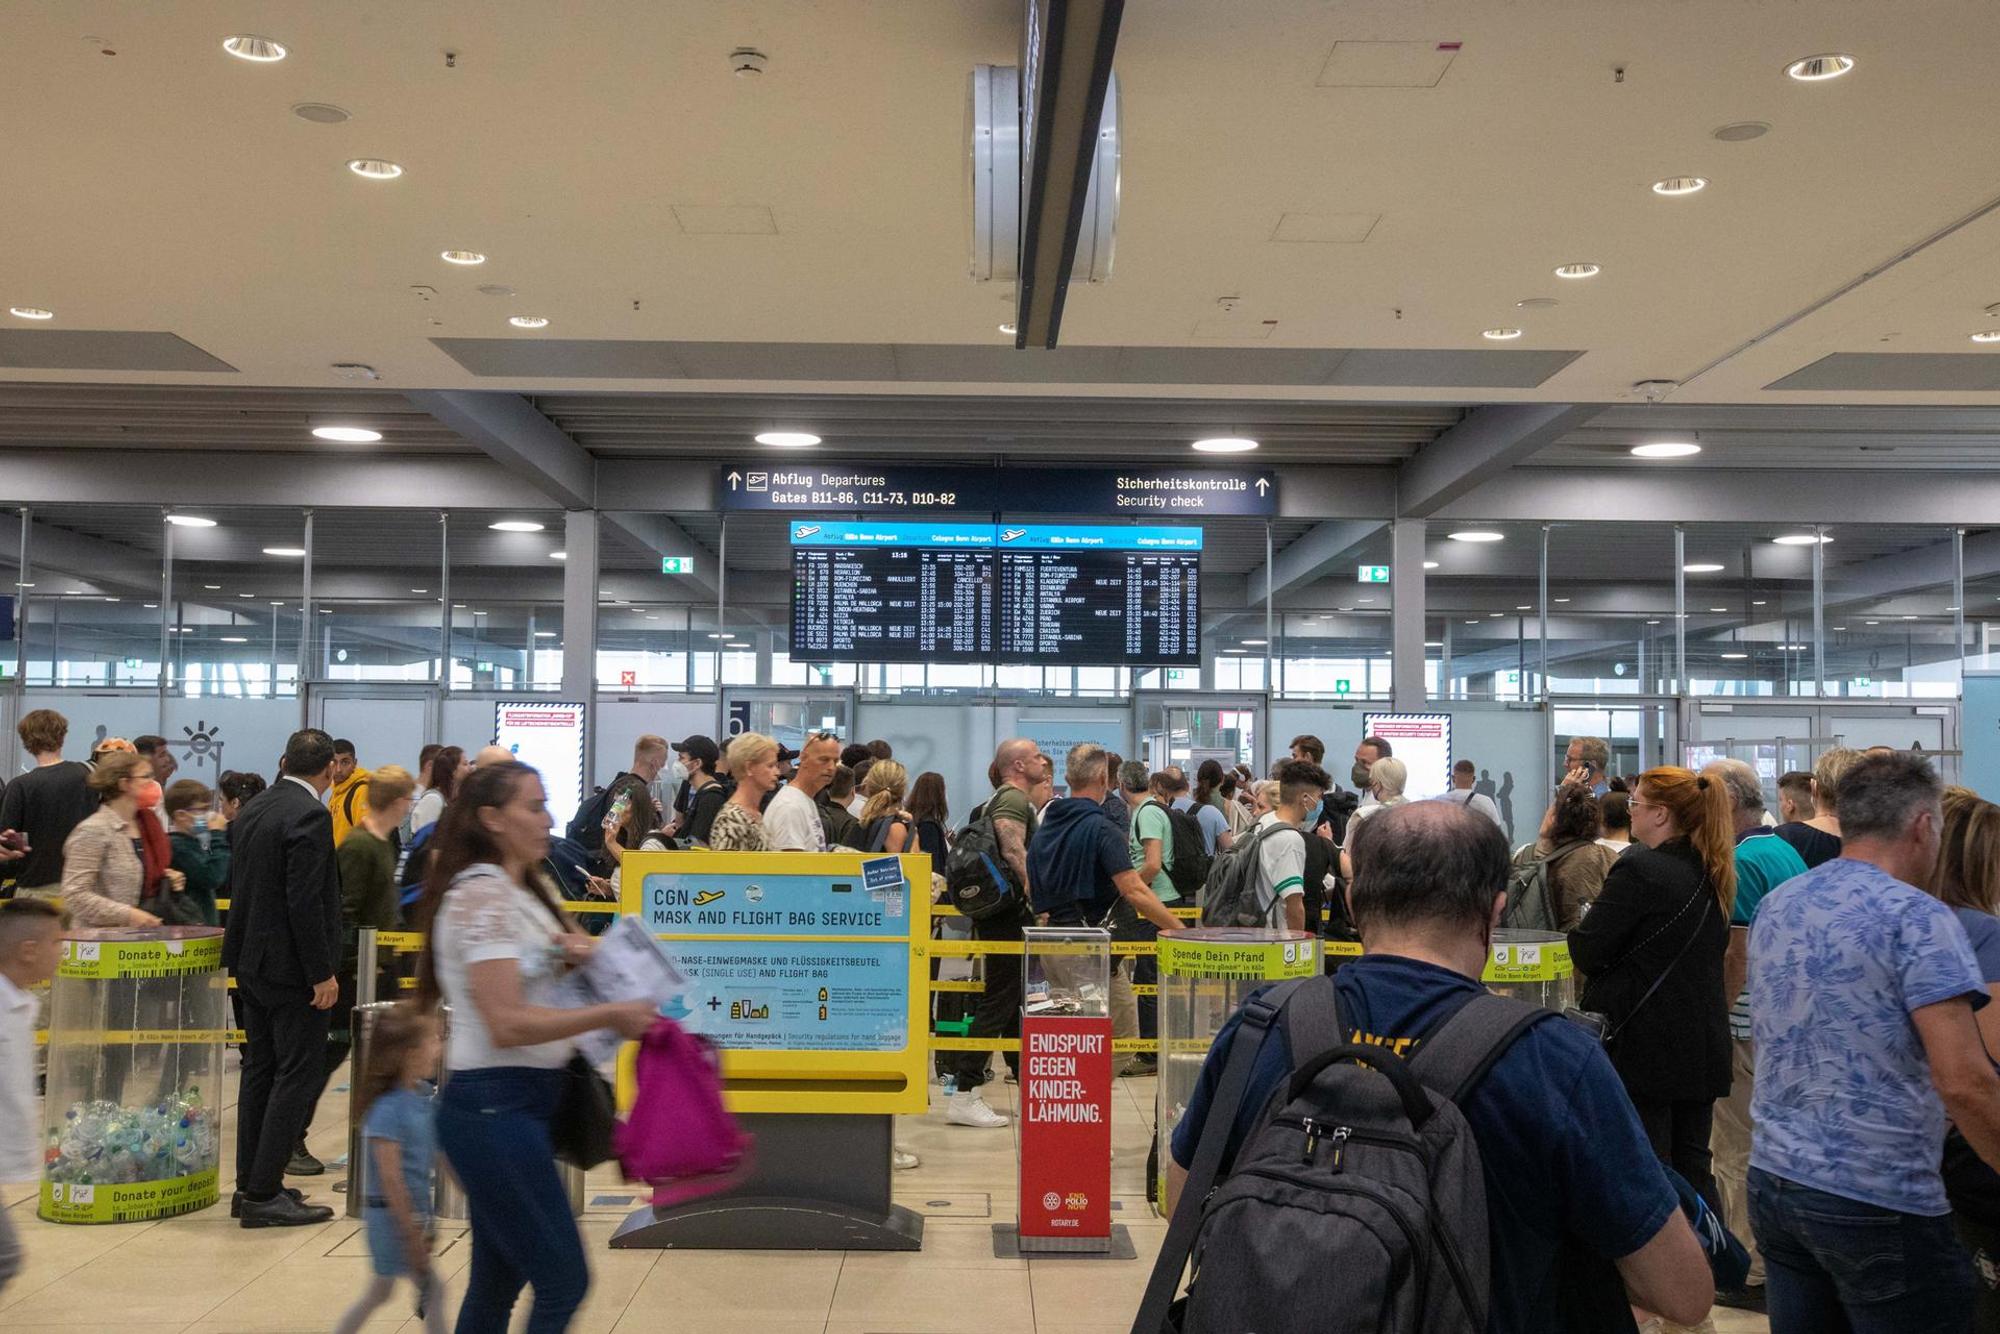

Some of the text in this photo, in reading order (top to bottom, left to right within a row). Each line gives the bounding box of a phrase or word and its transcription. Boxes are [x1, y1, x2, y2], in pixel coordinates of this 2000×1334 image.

[773, 473, 885, 487] Abflug Departures
[1117, 478, 1247, 490] Sicherheitskontrolle
[772, 492, 956, 506] Gates B11-86, C11-73, D10-82
[1117, 494, 1204, 508] Security check
[654, 890, 688, 905] CGN
[654, 910, 882, 926] MASK AND FLIGHT BAG SERVICE
[384, 936, 404, 945] Airport
[118, 950, 160, 960] Donate
[771, 956, 788, 966] UND
[792, 955, 880, 966] FLÜSSIGKEITSBEUTEL
[1173, 948, 1264, 962] Spende Dein Pfand
[759, 970, 776, 978] AND
[779, 970, 809, 978] FLIGHT
[812, 970, 828, 978] BAG
[1030, 1034, 1104, 1054] ENDSPURT
[1030, 1057, 1075, 1076] GEGEN
[1029, 1080, 1086, 1099] KINDER-
[1029, 1100, 1102, 1123] LÄHMUNG.
[113, 1176, 215, 1202] Donate your deposit
